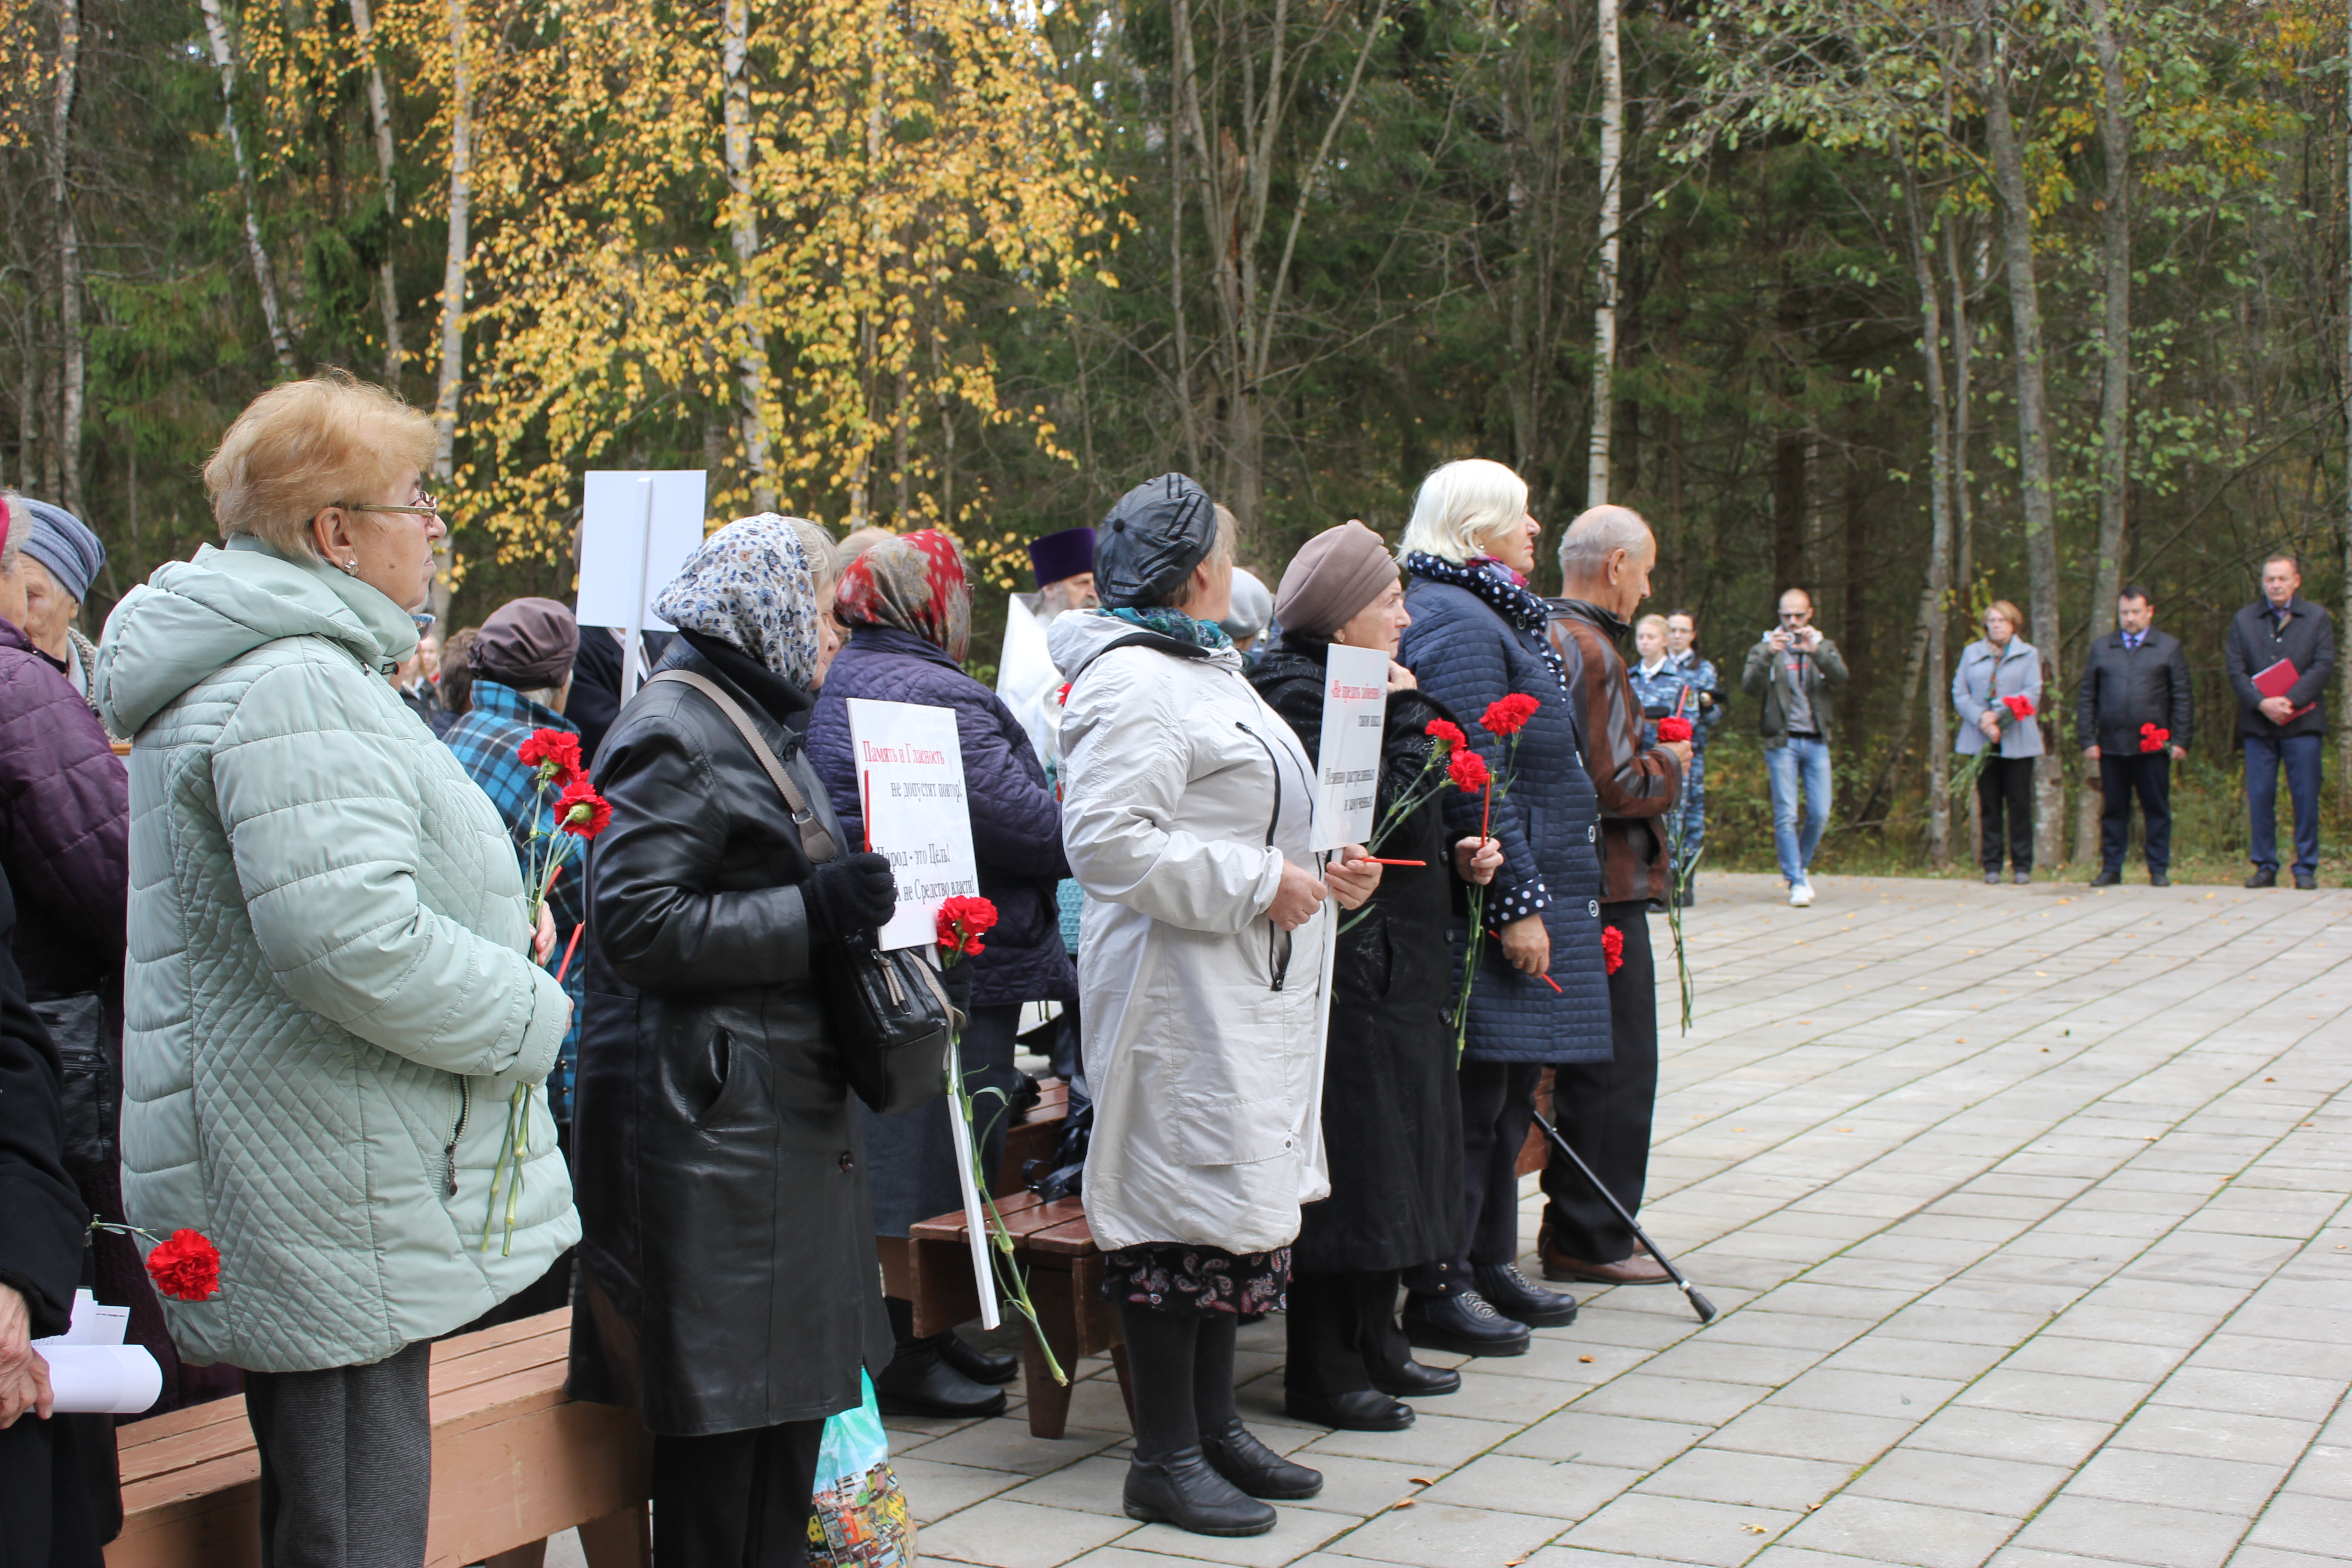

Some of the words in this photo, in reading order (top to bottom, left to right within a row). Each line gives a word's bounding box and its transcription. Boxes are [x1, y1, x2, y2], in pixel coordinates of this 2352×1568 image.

[862, 741, 897, 763] Память
[898, 749, 905, 763] и
[905, 743, 945, 764] Гласность
[891, 782, 901, 797] не
[903, 783, 936, 802] допустят
[937, 779, 962, 803] повтор!
[914, 850, 927, 865] это
[928, 843, 951, 867] Цель!
[902, 886, 913, 901] не
[914, 878, 950, 905] Средство
[950, 874, 975, 896] власти!
